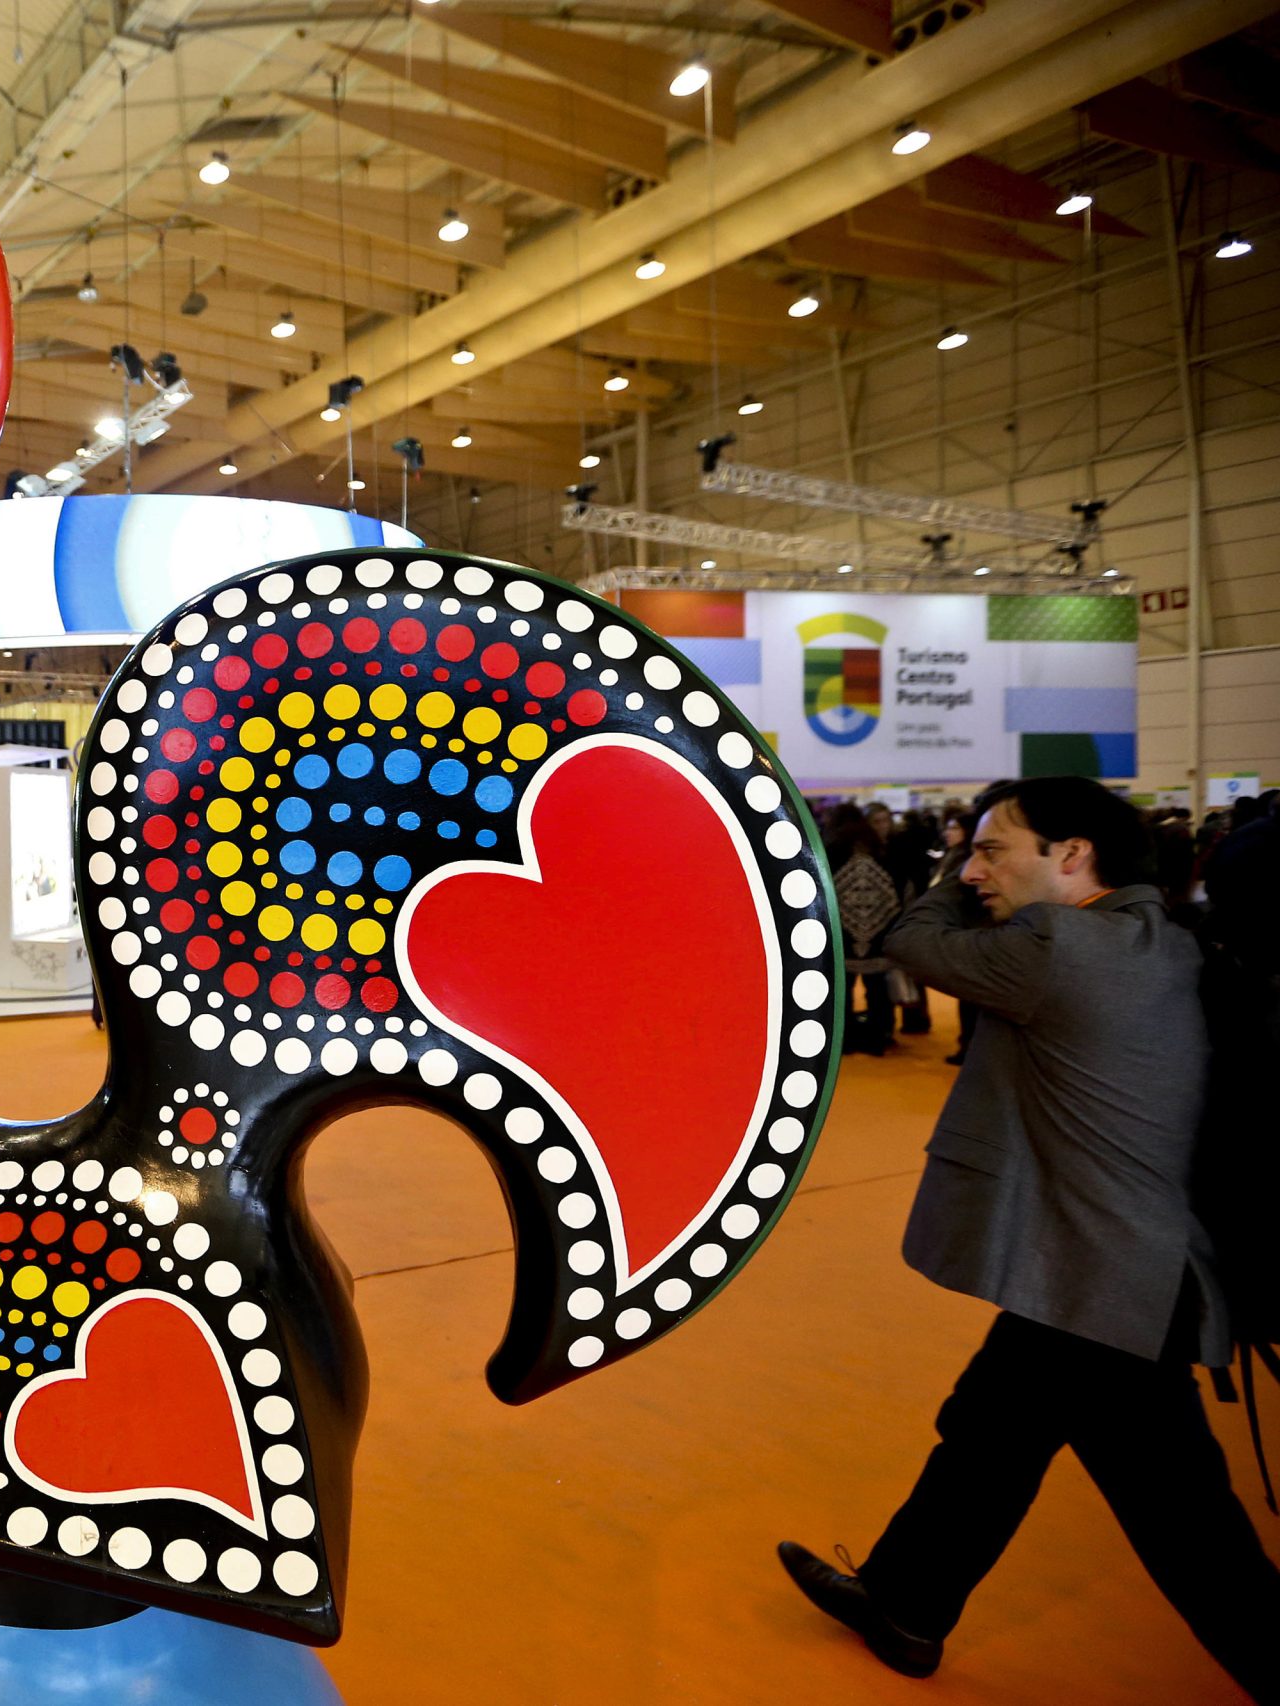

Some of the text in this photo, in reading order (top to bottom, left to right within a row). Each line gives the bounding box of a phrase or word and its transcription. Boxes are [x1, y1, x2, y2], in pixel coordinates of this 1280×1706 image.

[897, 646, 968, 665] Turismo
[896, 667, 955, 685] Centro
[896, 688, 973, 711] Portugal
